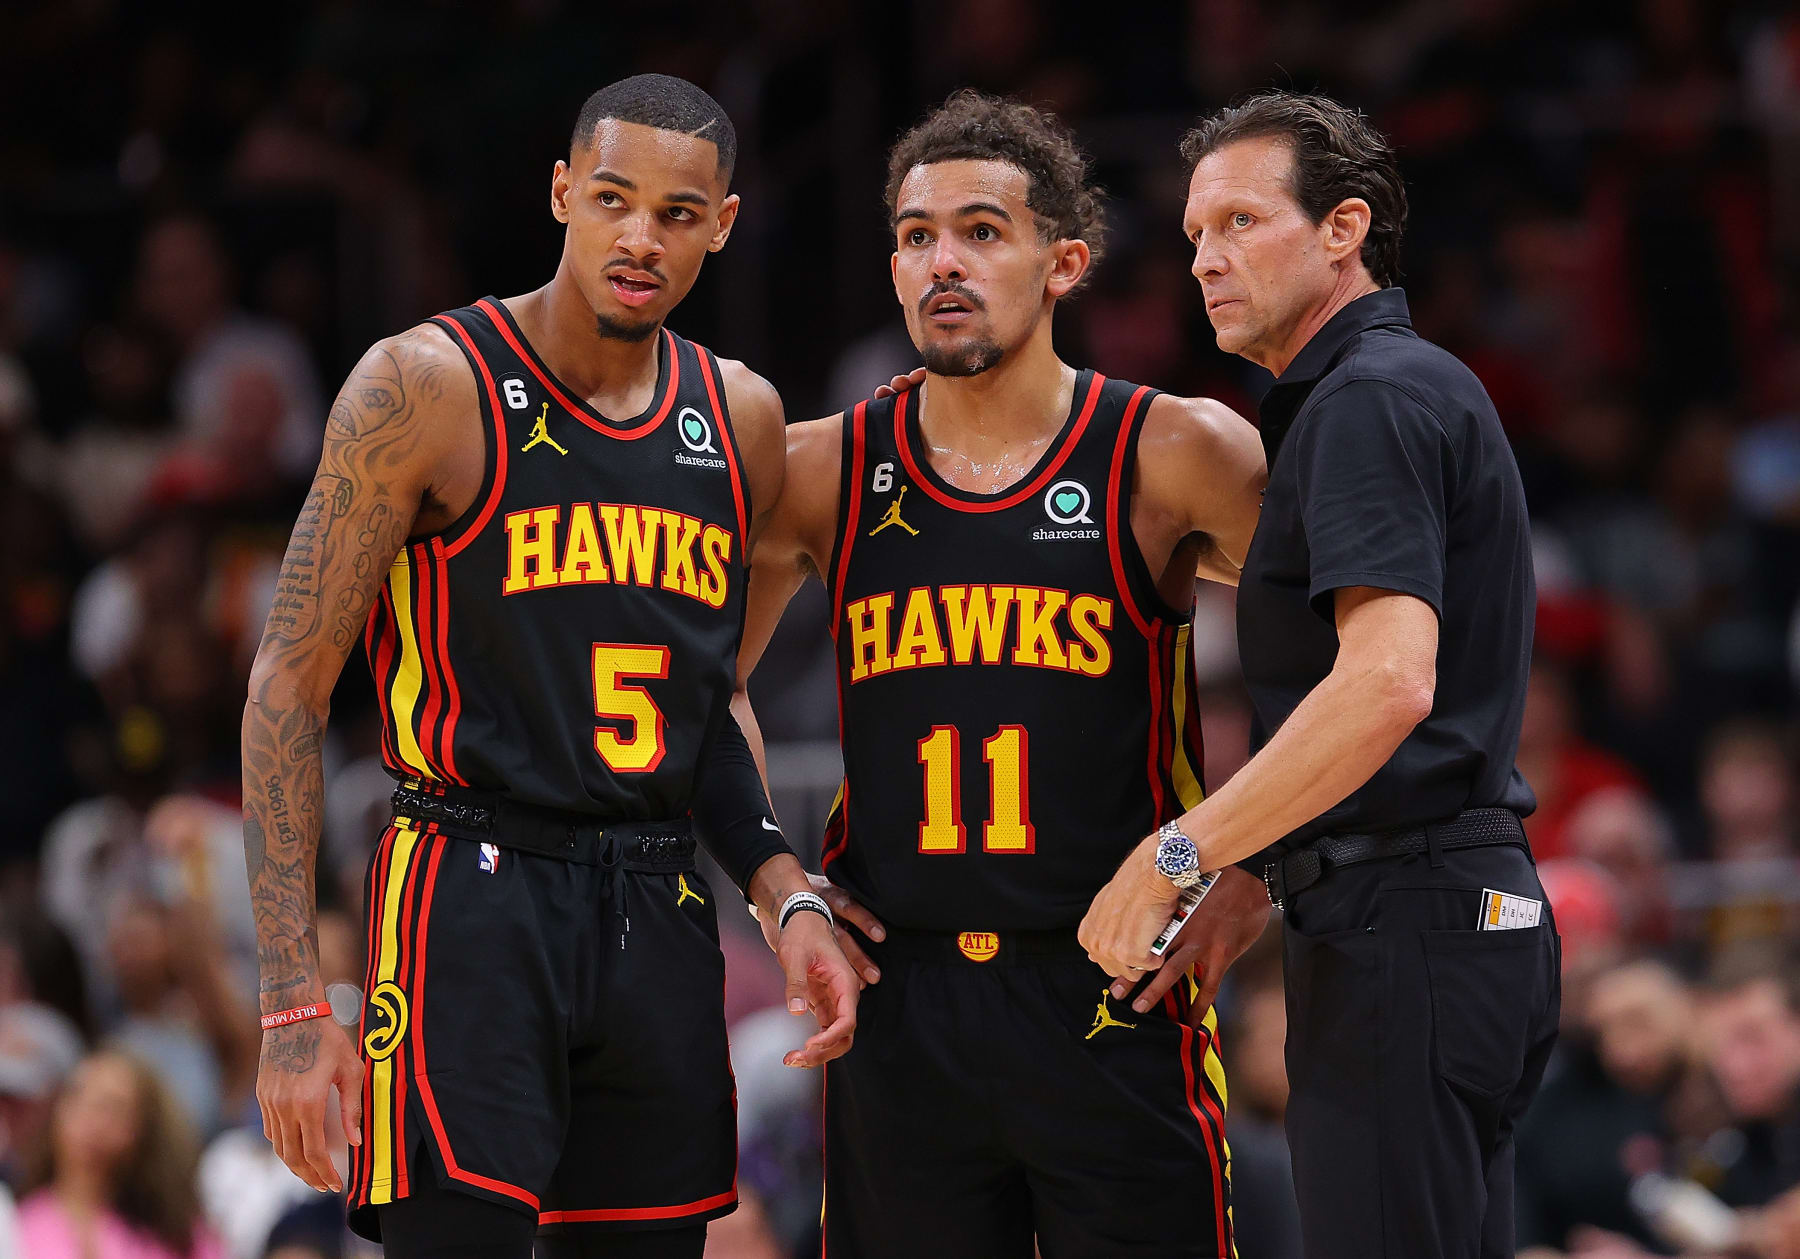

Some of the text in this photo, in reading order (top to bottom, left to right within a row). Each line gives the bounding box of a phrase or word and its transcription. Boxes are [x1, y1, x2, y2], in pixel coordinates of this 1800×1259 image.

[502, 378, 529, 410] 6
[675, 452, 727, 469] sharecare
[872, 462, 894, 493] 6
[1032, 527, 1100, 541] sharecare
[502, 501, 734, 610] HAWKS
[846, 584, 1113, 686] HAWKS
[592, 641, 672, 774] 5
[917, 723, 1036, 855] 11
[963, 933, 994, 950] ATL
[289, 1006, 318, 1021] RILEY
